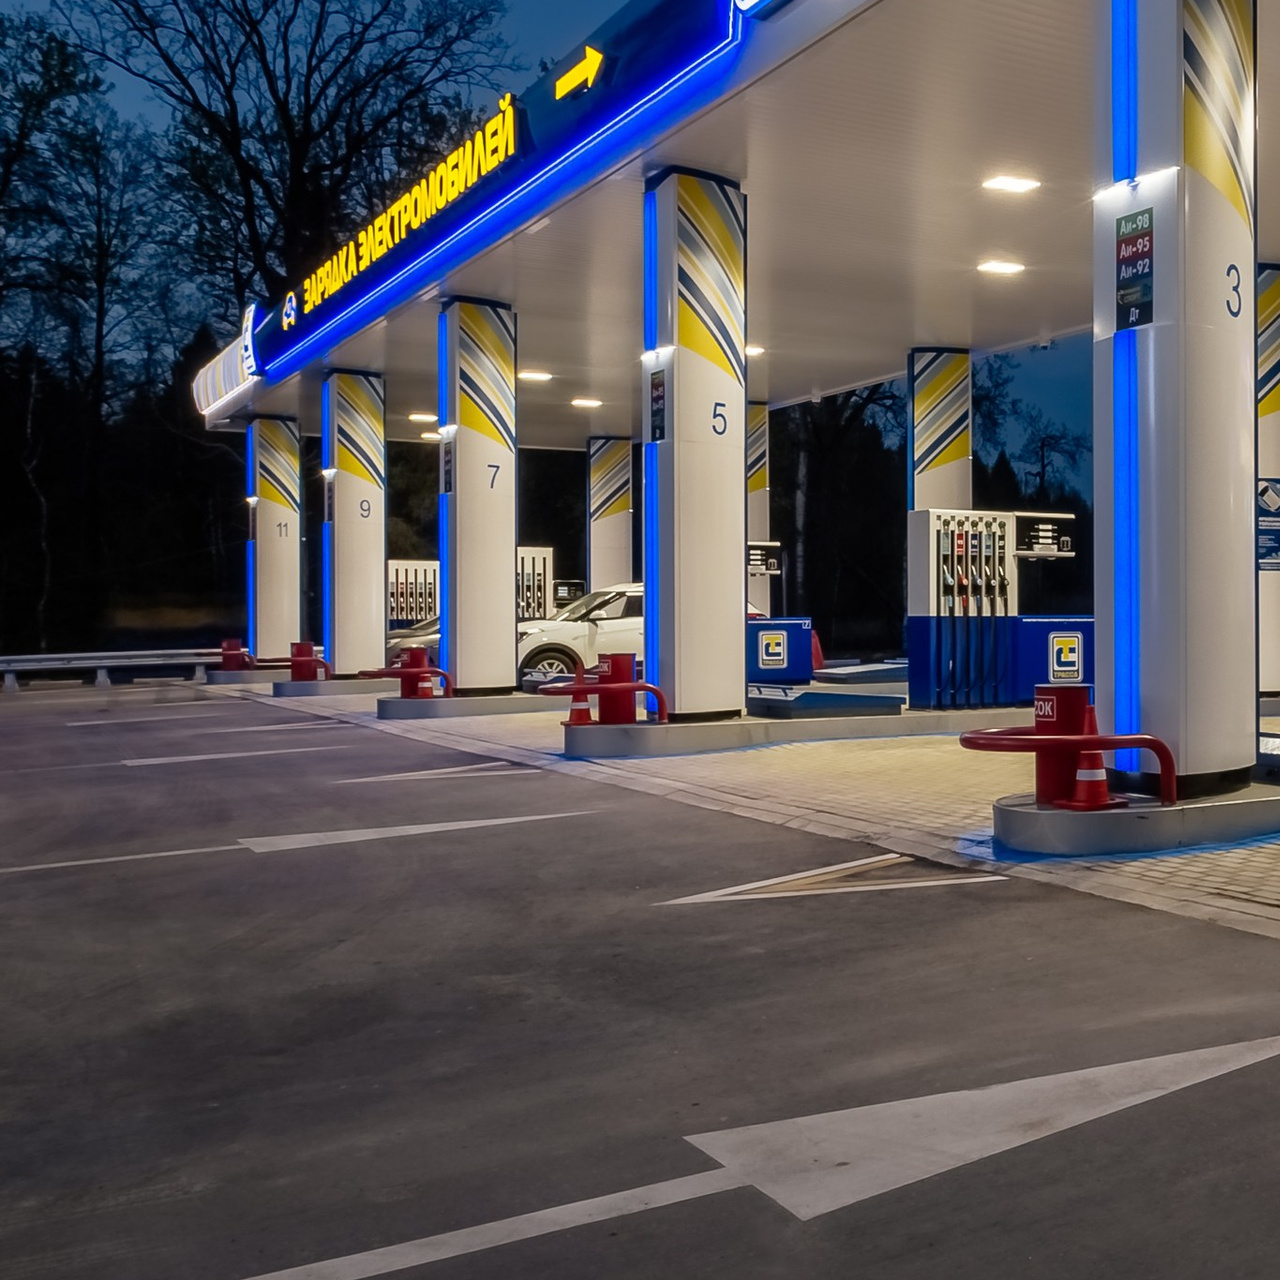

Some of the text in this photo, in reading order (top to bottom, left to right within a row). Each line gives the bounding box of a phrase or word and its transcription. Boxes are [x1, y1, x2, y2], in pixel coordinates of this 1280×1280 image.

[304, 93, 515, 314] ЗАРЯДКА ЭЛЕКТРОМОБИЛЕЙ
[1120, 214, 1149, 235] Аи-98
[1120, 237, 1150, 259] Аи-95
[1120, 259, 1150, 280] Аи-92
[1226, 264, 1242, 318] 3
[712, 402, 727, 436] 5
[487, 464, 500, 489] 7
[359, 500, 371, 518] 9
[276, 522, 289, 538] 11
